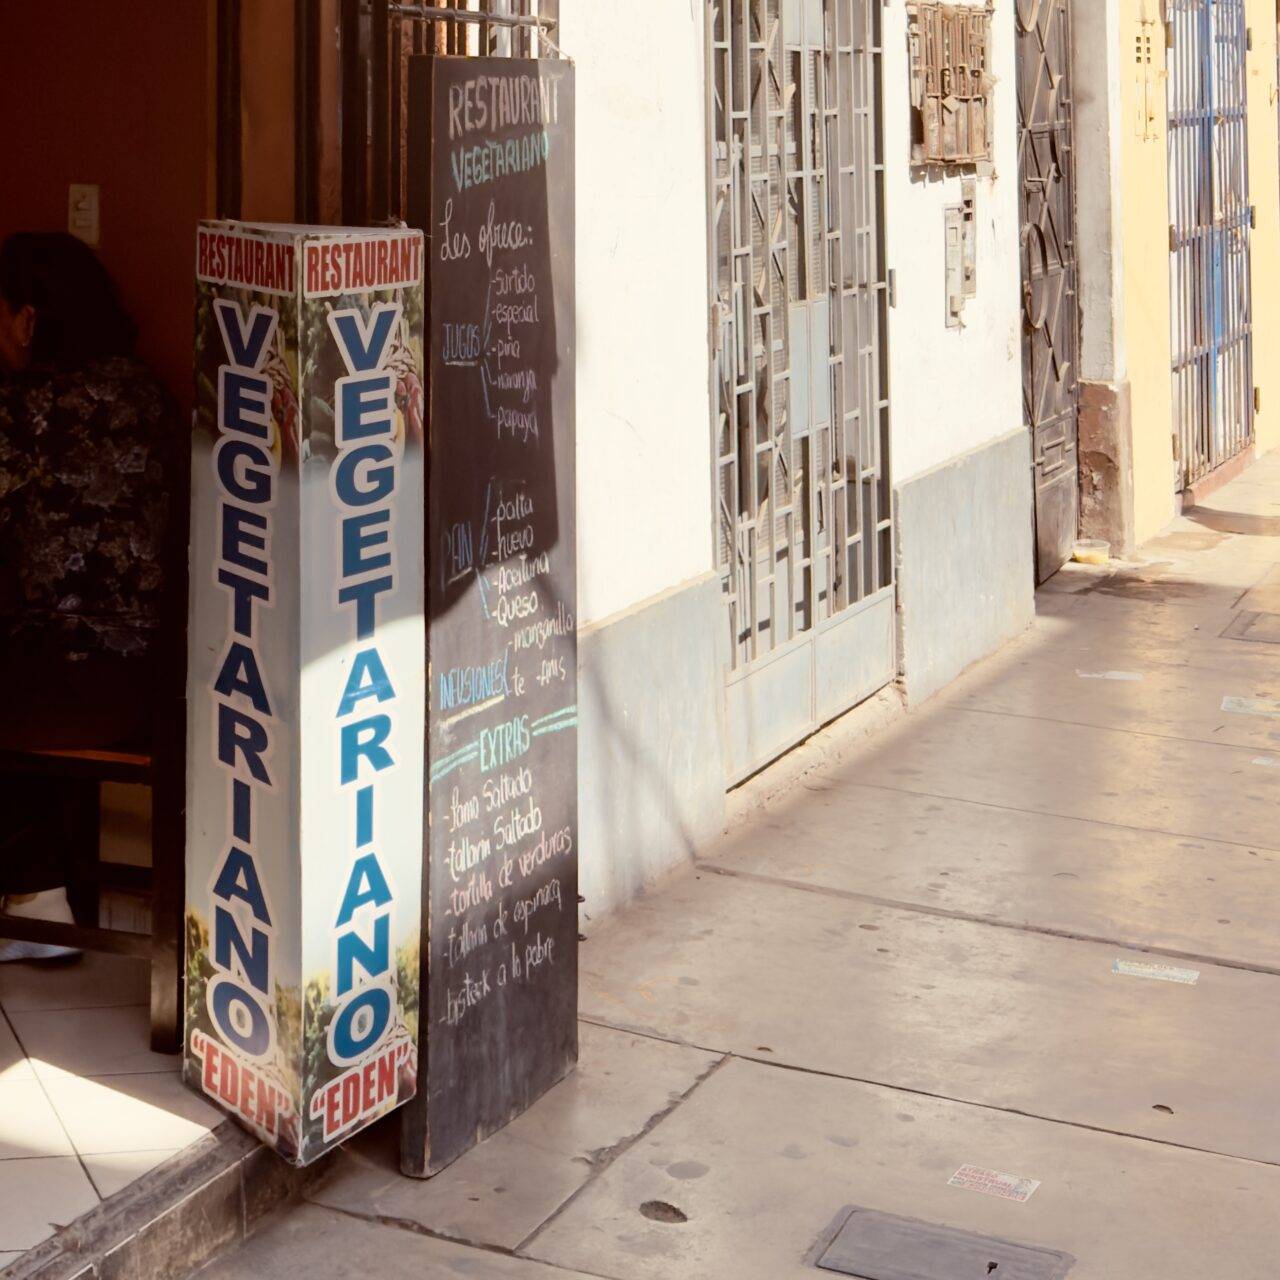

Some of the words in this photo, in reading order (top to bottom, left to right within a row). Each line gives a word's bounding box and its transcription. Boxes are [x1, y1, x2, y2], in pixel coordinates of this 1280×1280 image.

[448, 73, 565, 141] RESTAURANT
[450, 130, 550, 193] VEGETARIANO
[198, 231, 295, 293] RESTAURANT
[306, 236, 421, 293] RESTAURANT
[442, 322, 481, 362] JUGOS
[210, 303, 278, 1059] VEGETARIANO
[331, 305, 401, 1061] VEGETARIANO
[479, 715, 531, 773] EXTRAS
[498, 855, 513, 888] de
